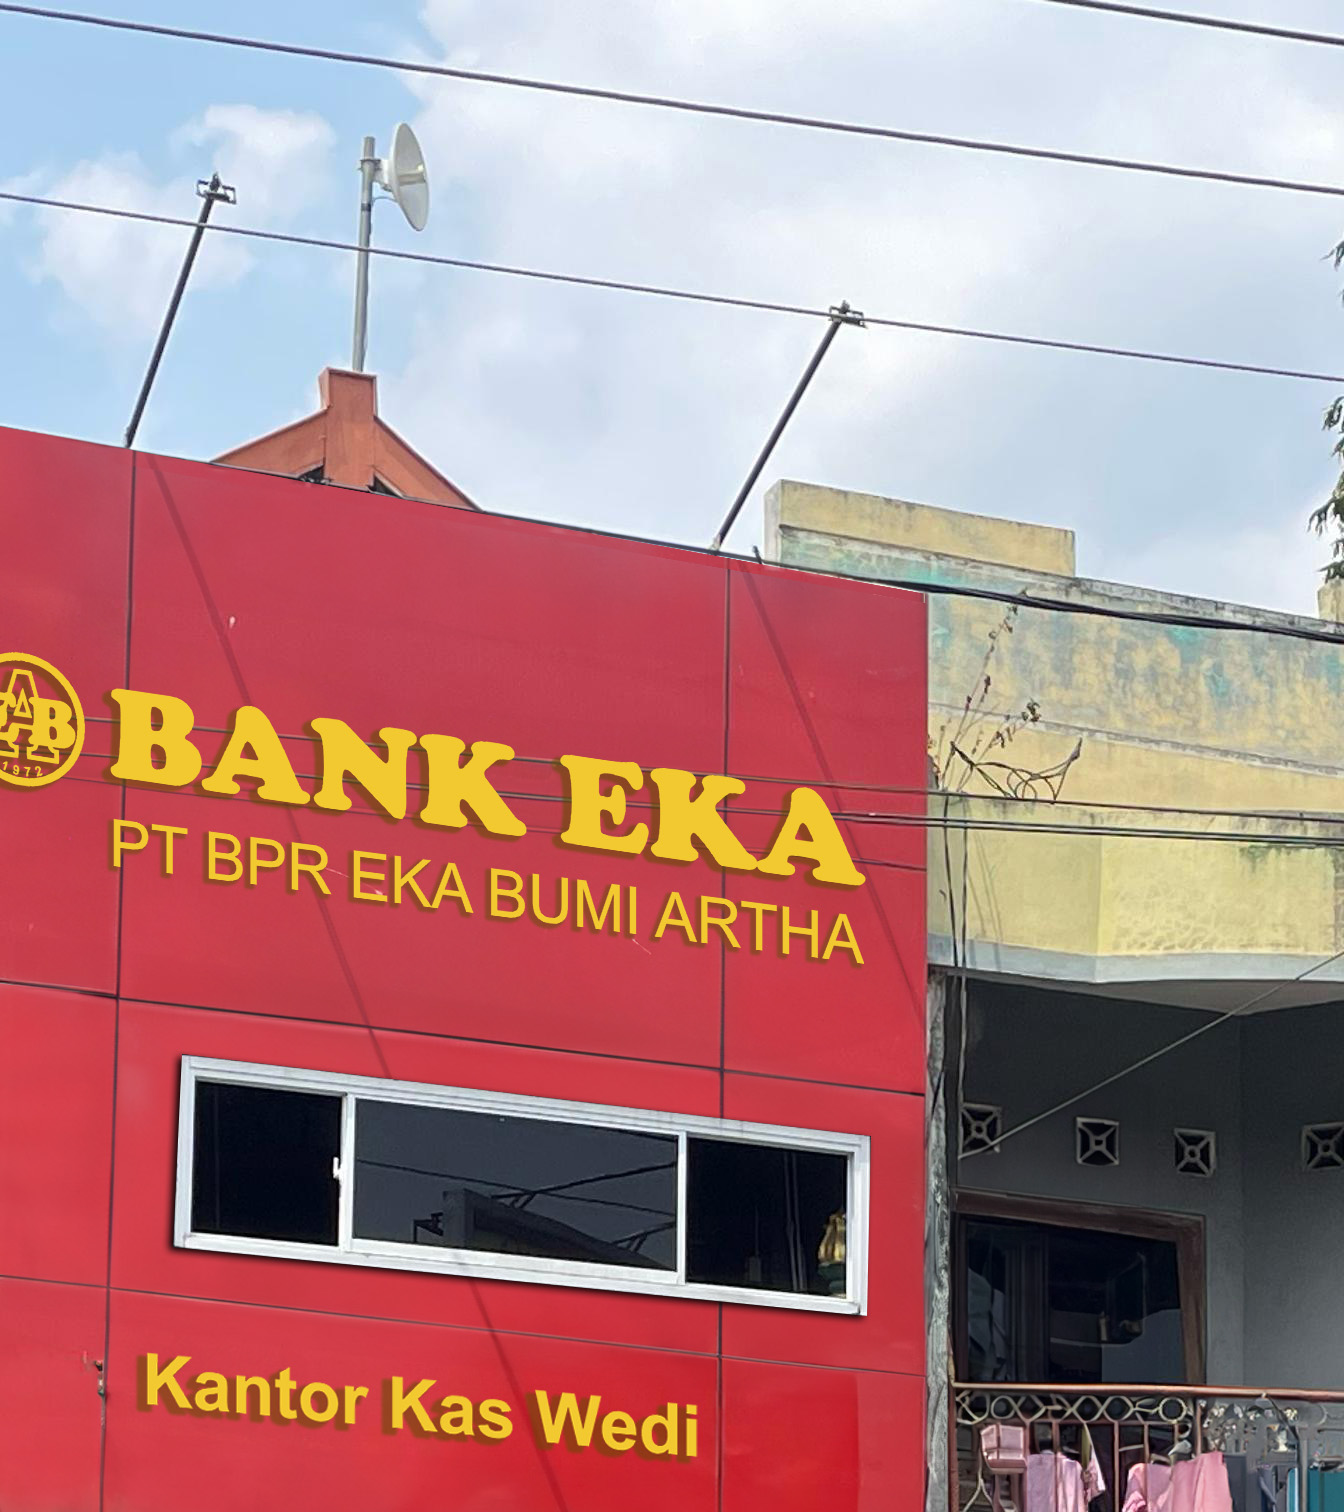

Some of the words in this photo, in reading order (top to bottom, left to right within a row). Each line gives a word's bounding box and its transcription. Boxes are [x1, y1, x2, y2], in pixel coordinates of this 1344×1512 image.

[2, 761, 44, 777] 1972
[110, 688, 527, 837] BANK
[560, 754, 866, 886] EKA
[112, 818, 188, 875] PT
[207, 830, 332, 895] BPR
[353, 849, 474, 914] EKA
[489, 867, 638, 935] BUMI
[654, 890, 865, 965] ARTHA
[146, 1352, 369, 1425] Kantor
[391, 1375, 514, 1440] Kas
[534, 1388, 699, 1458] Wedi
